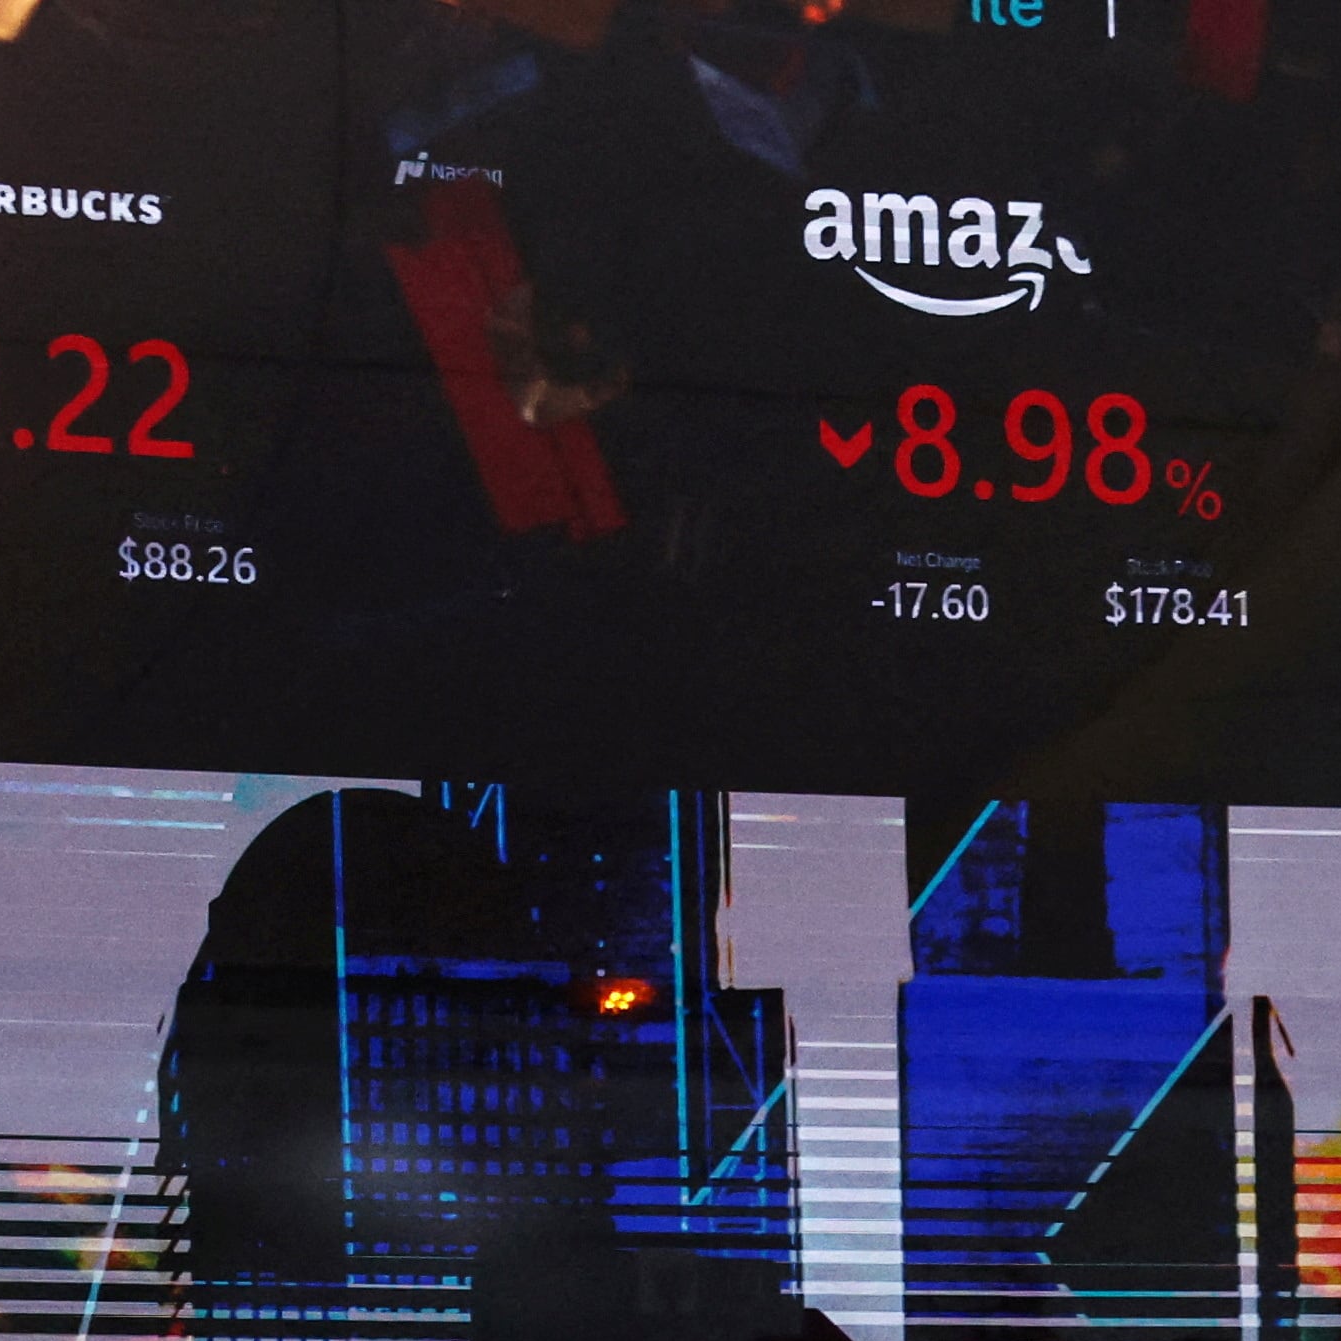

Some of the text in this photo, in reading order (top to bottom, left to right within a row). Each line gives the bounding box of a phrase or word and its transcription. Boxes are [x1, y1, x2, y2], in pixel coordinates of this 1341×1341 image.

[117, 535, 258, 586] $88.26
[871, 581, 991, 622] -17.60
[1104, 580, 1250, 628] $178.41
